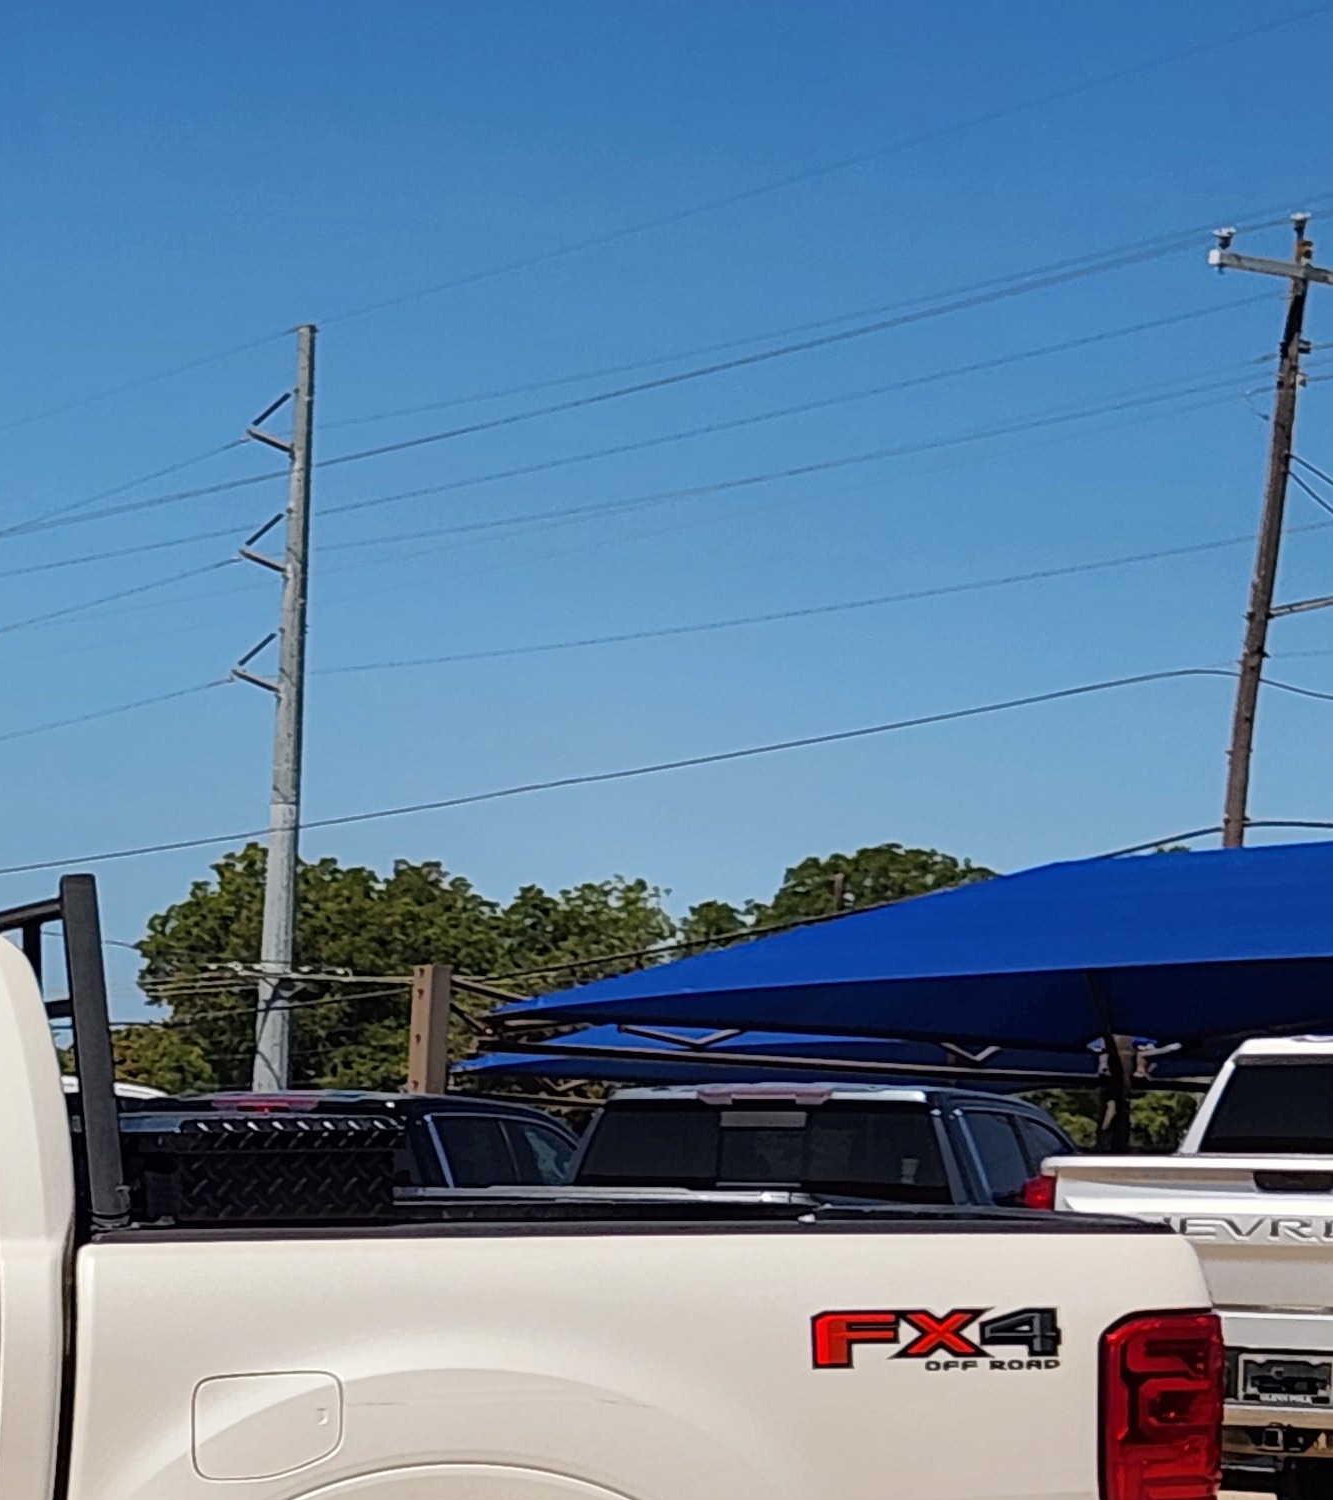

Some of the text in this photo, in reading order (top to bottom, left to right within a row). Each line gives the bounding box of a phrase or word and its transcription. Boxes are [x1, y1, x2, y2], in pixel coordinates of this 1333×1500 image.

[1165, 1216, 1333, 1243] EVR
[809, 1306, 1063, 1371] FX4
[924, 1358, 1062, 1372] OFF ROAD
